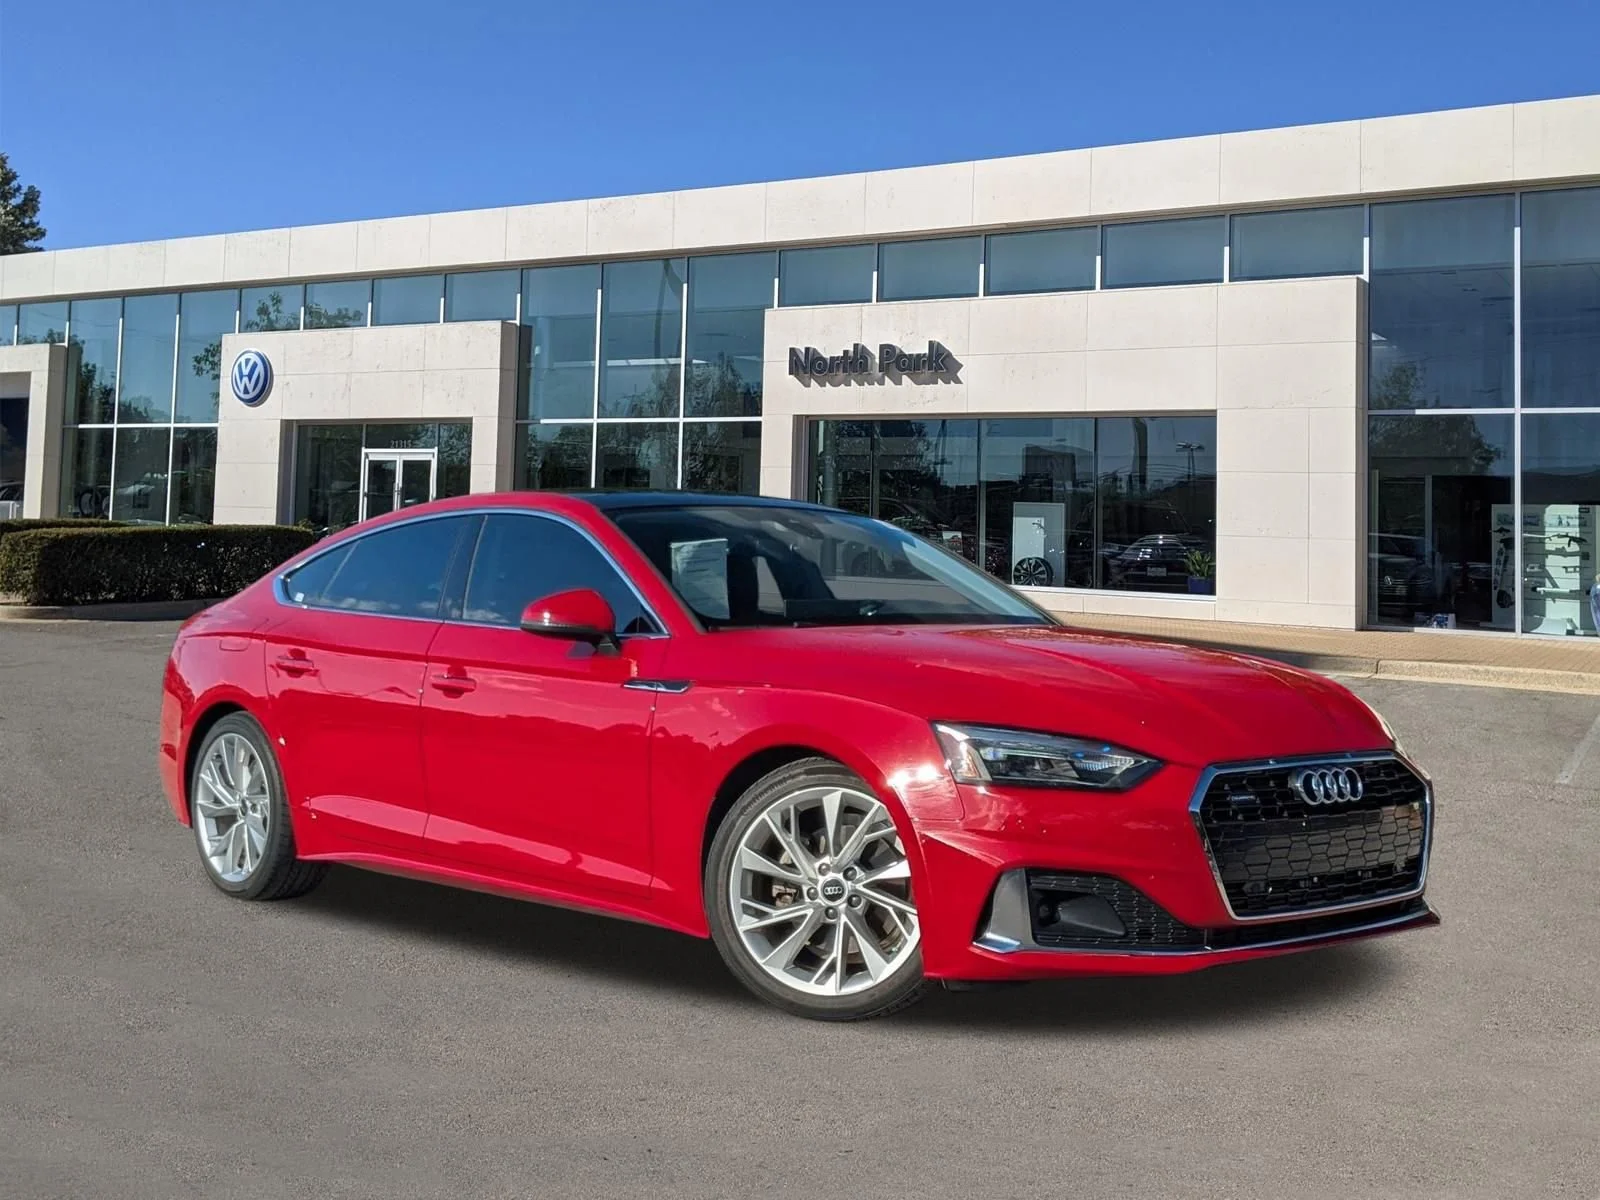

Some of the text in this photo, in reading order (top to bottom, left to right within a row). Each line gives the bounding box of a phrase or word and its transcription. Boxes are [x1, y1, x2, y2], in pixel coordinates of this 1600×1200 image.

[233, 353, 265, 399] VW
[788, 340, 949, 377] North Park
